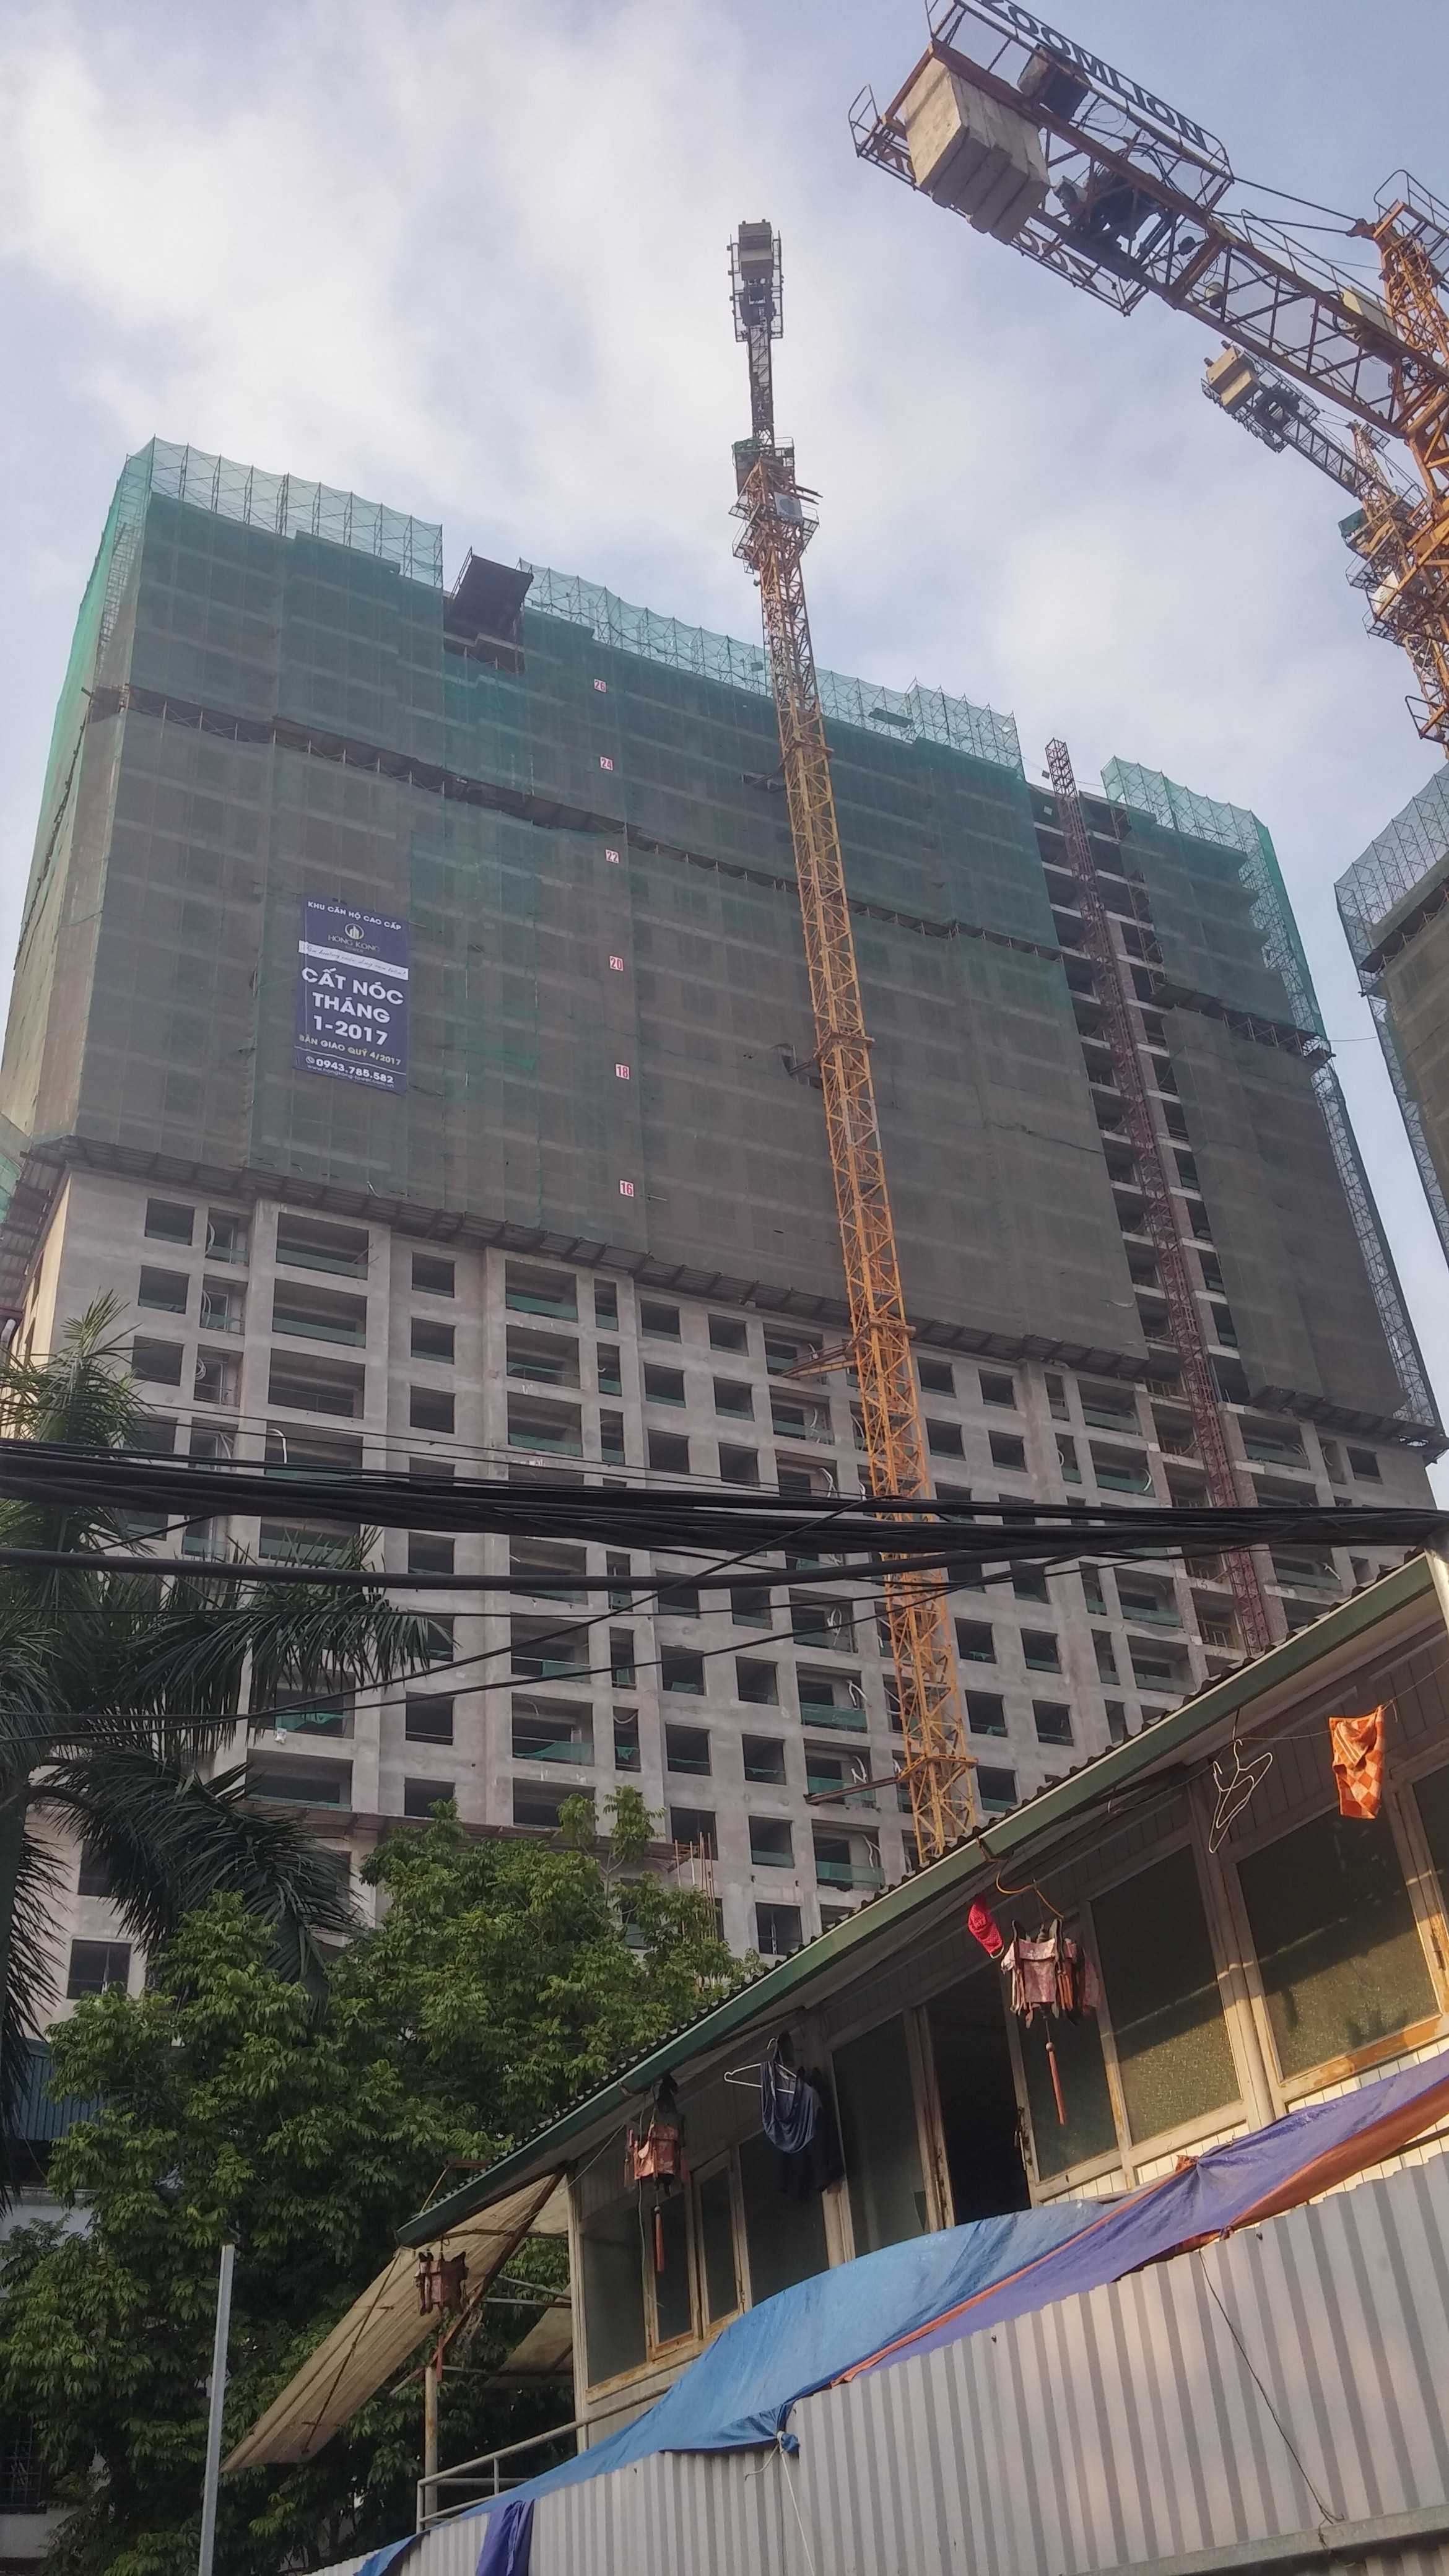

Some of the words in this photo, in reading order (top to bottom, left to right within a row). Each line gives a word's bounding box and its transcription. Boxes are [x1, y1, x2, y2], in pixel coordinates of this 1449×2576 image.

[595, 680, 606, 692] 26
[601, 758, 612, 770] 24
[606, 851, 618, 863] 22
[308, 901, 325, 910] KHU
[328, 906, 346, 915] CĂN
[348, 911, 361, 921] HỘ
[363, 915, 382, 925] CAO
[384, 921, 402, 931] CẤP
[328, 934, 353, 946] HONG
[611, 957, 622, 970] 20
[302, 967, 346, 990] CẤT
[352, 981, 404, 1005] NÓC
[312, 991, 391, 1024] THÁNG
[313, 1015, 388, 1046] 1-2017
[320, 1040, 346, 1051] GIAO
[347, 1046, 368, 1058] QUÝ
[369, 1051, 402, 1066] 4/2017
[316, 1058, 394, 1084] 0943.785.582
[617, 1065, 629, 1079] 18
[620, 1181, 633, 1196] 16
